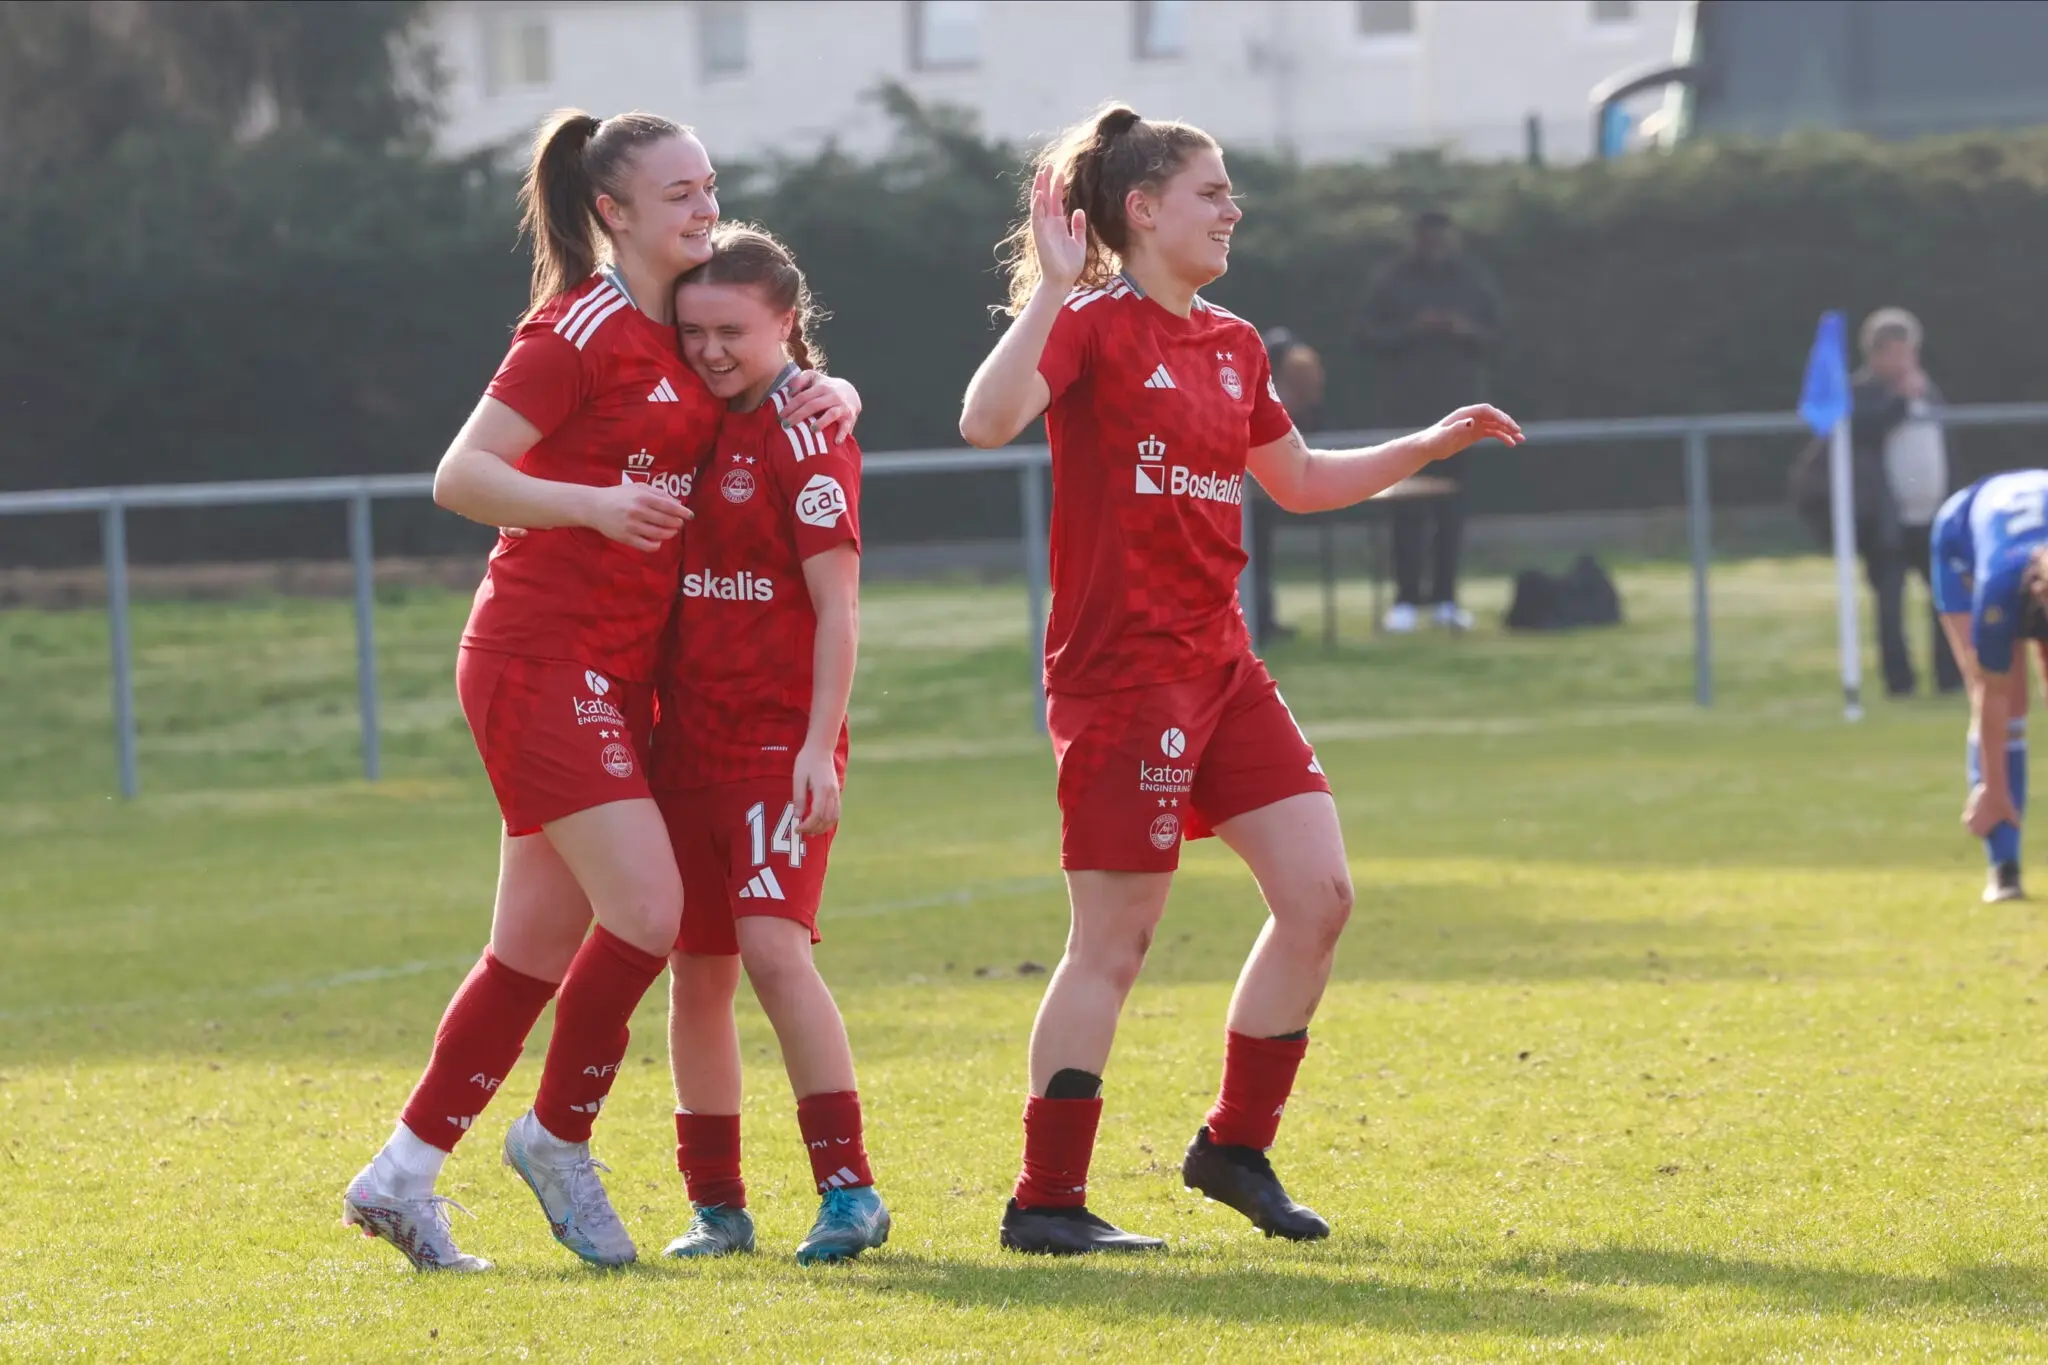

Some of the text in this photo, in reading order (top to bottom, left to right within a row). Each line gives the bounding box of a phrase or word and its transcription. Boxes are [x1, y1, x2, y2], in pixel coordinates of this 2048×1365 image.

[651, 467, 697, 497] Bos
[1171, 465, 1242, 506] Boskalis
[682, 568, 774, 602] skalis
[1140, 759, 1195, 783] katoni
[746, 801, 806, 868] 14
